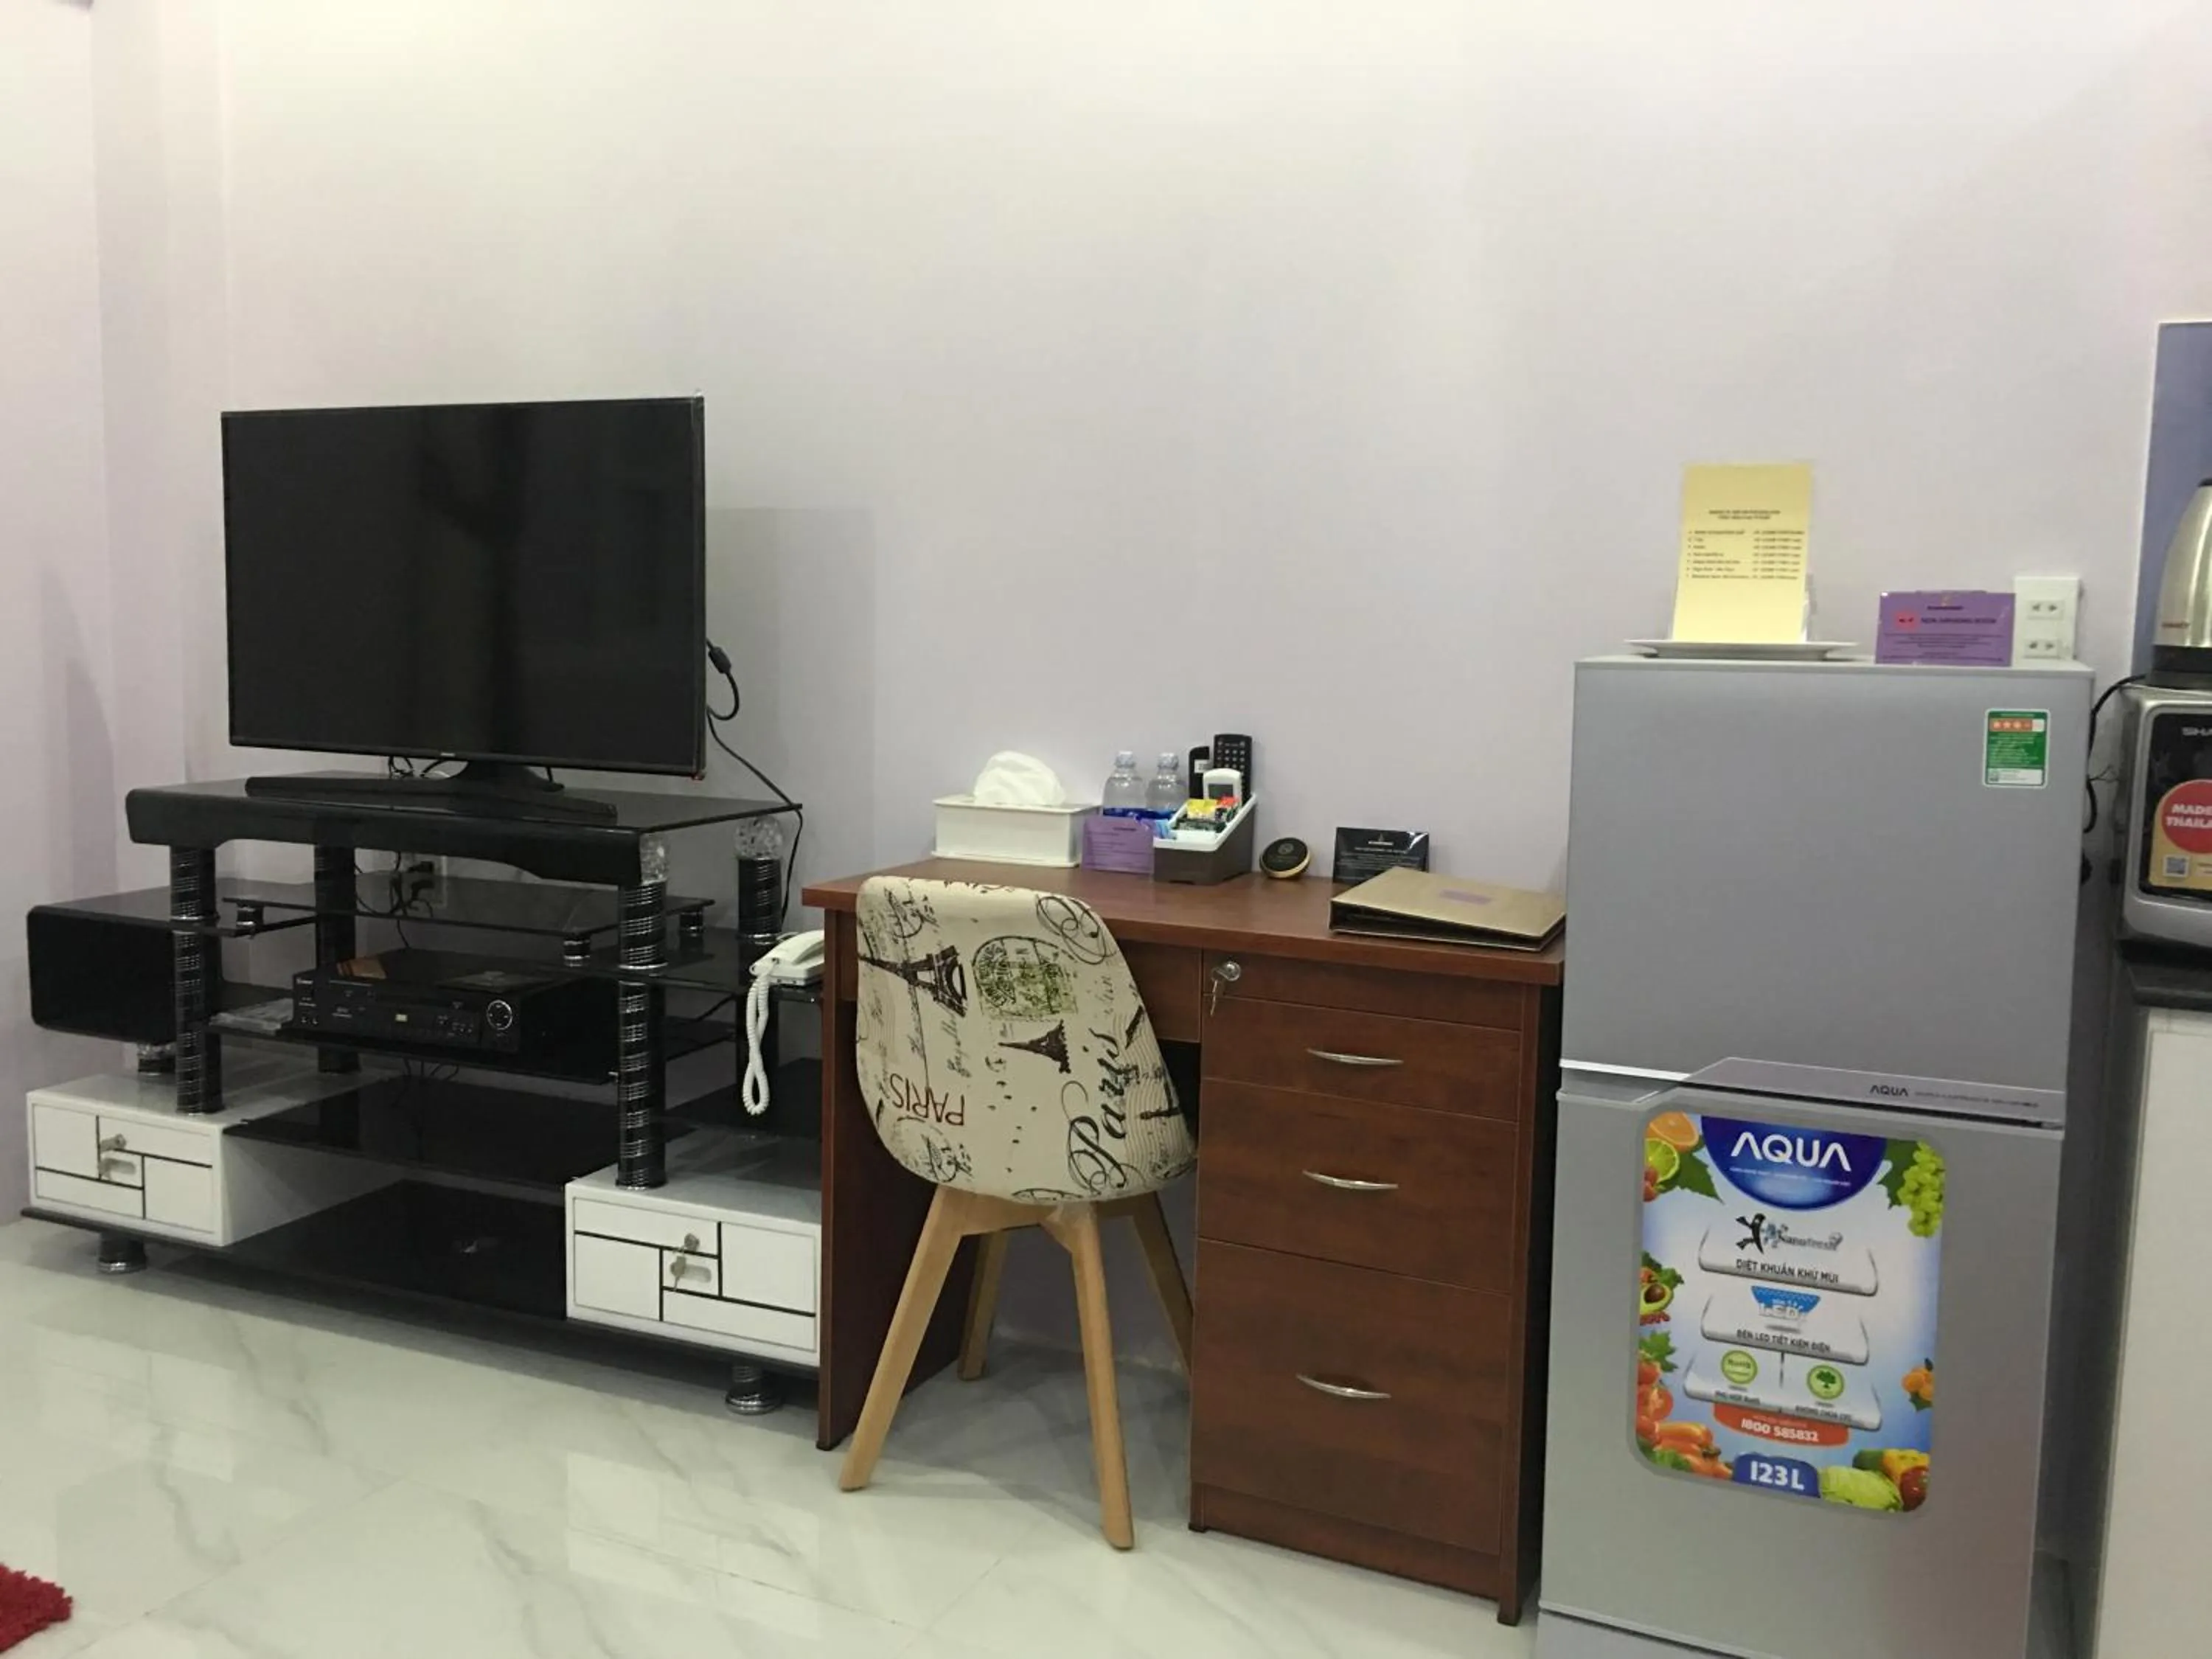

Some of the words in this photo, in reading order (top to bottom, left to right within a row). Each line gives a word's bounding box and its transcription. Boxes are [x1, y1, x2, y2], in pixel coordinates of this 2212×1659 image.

[890, 1073, 965, 1126] PARIS
[1869, 1085, 1909, 1097] AQUA
[1731, 1132, 1851, 1172] AQUA
[1741, 1418, 1770, 1435] 1800
